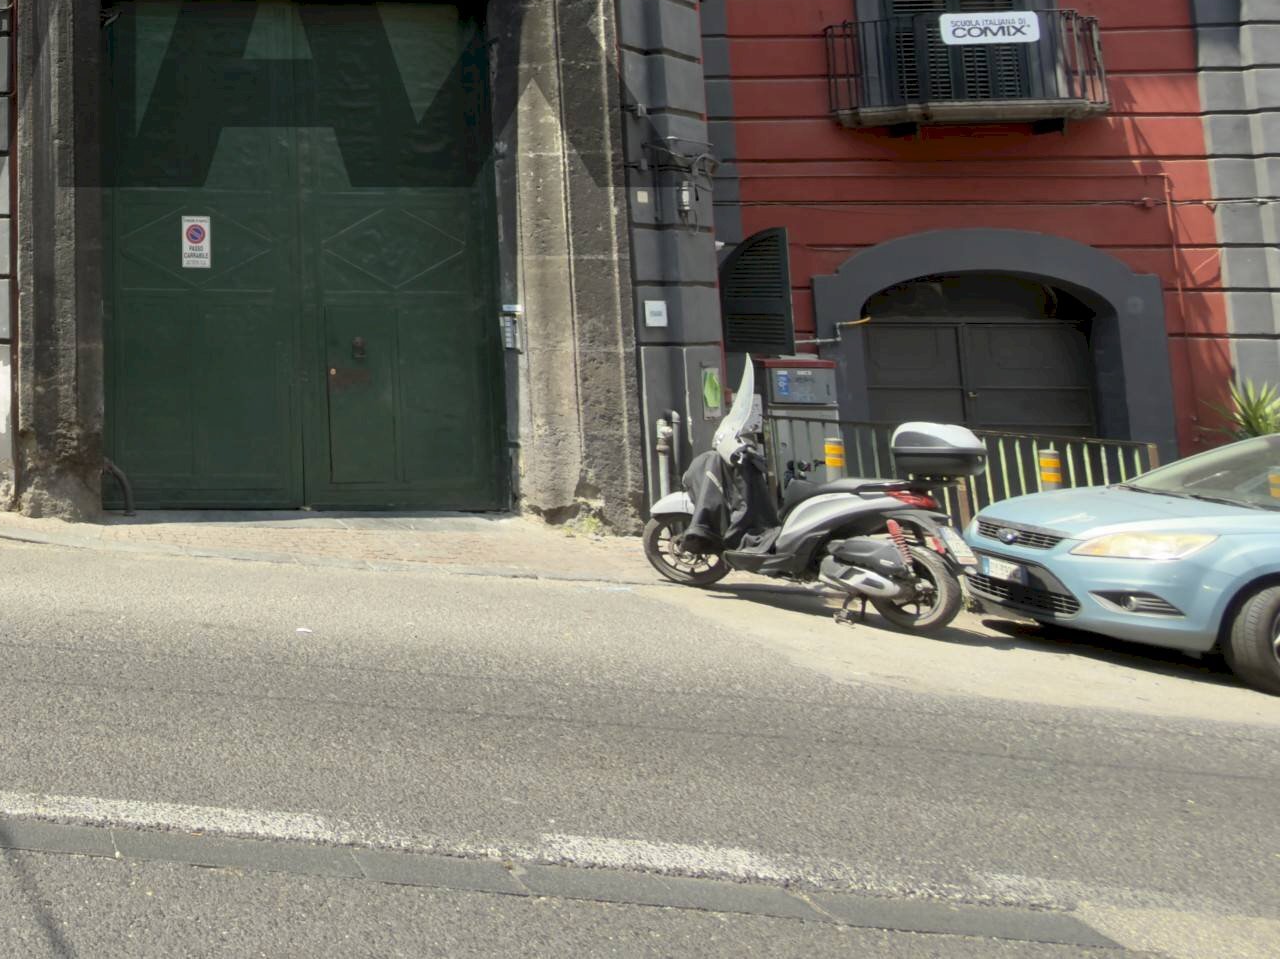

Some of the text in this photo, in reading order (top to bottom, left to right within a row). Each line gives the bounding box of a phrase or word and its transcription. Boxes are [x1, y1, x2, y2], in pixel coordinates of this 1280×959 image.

[950, 17, 1026, 28] SCUOLA ITALIANA DI
[951, 25, 1027, 38] COMIX
